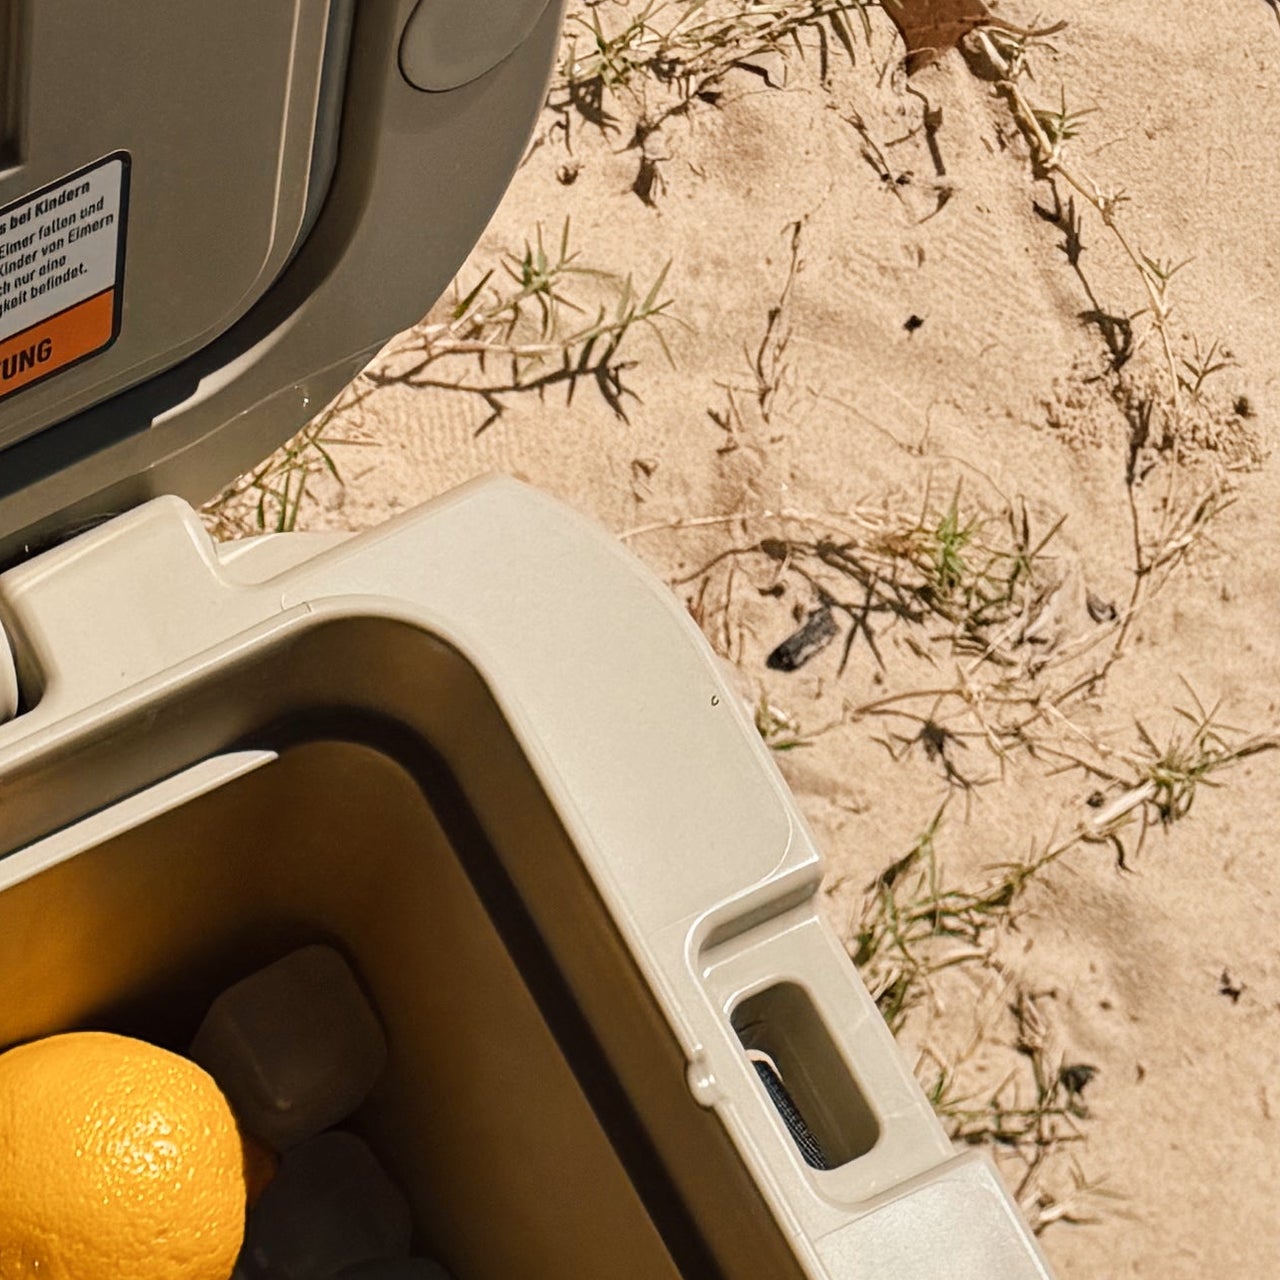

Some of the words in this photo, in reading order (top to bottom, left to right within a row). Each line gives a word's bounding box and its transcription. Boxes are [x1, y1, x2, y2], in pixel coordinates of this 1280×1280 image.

[8, 205, 32, 231] bei
[33, 180, 91, 219] Kindern
[37, 211, 77, 241] fallen
[78, 194, 105, 220] und
[40, 236, 65, 257] von
[66, 212, 114, 245] Eimern
[12, 267, 36, 290] nur
[37, 253, 67, 278] eine
[29, 260, 88, 300] befindet.
